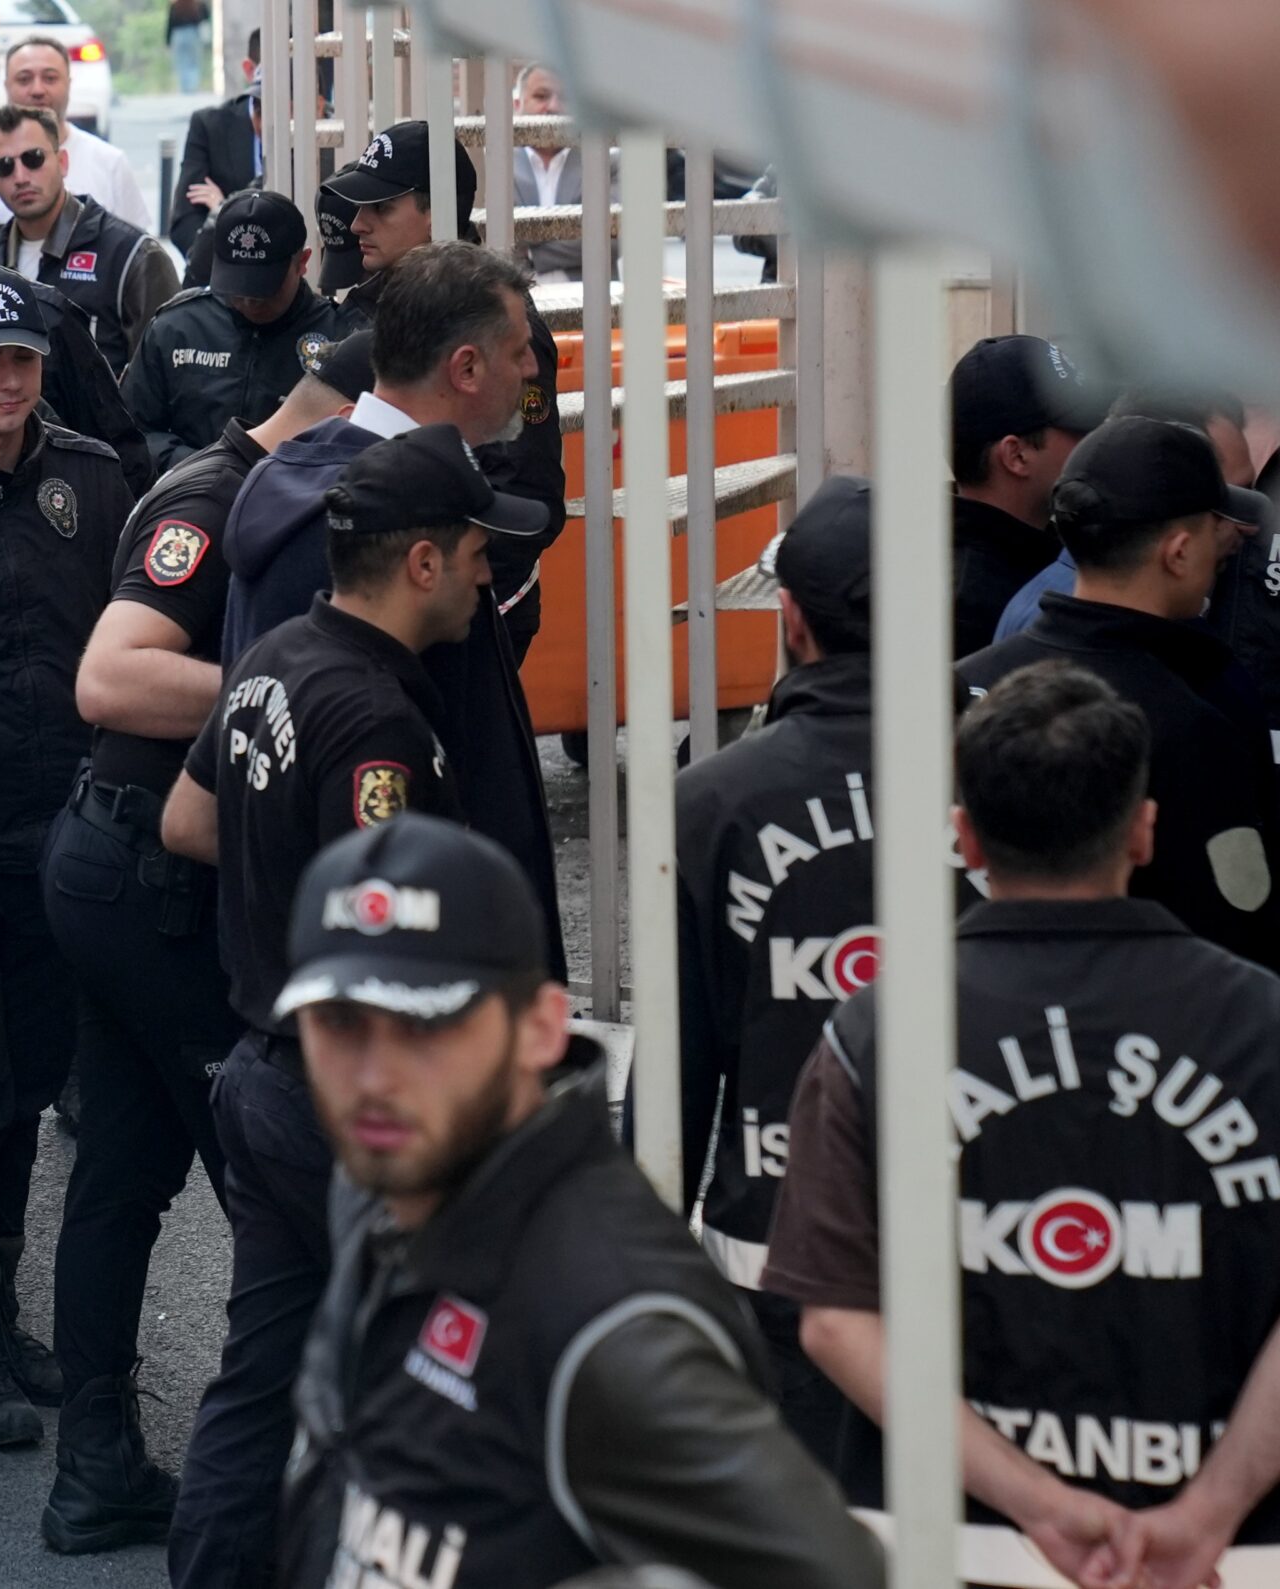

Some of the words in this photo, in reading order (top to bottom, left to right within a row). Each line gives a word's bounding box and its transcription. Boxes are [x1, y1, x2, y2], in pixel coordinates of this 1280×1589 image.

[195, 350, 232, 367] KUVVET
[726, 772, 875, 944] MALİ
[946, 1004, 1082, 1162] ALİ
[1106, 1032, 1280, 1209] ŞUBE
[957, 1186, 1203, 1290] KOM
